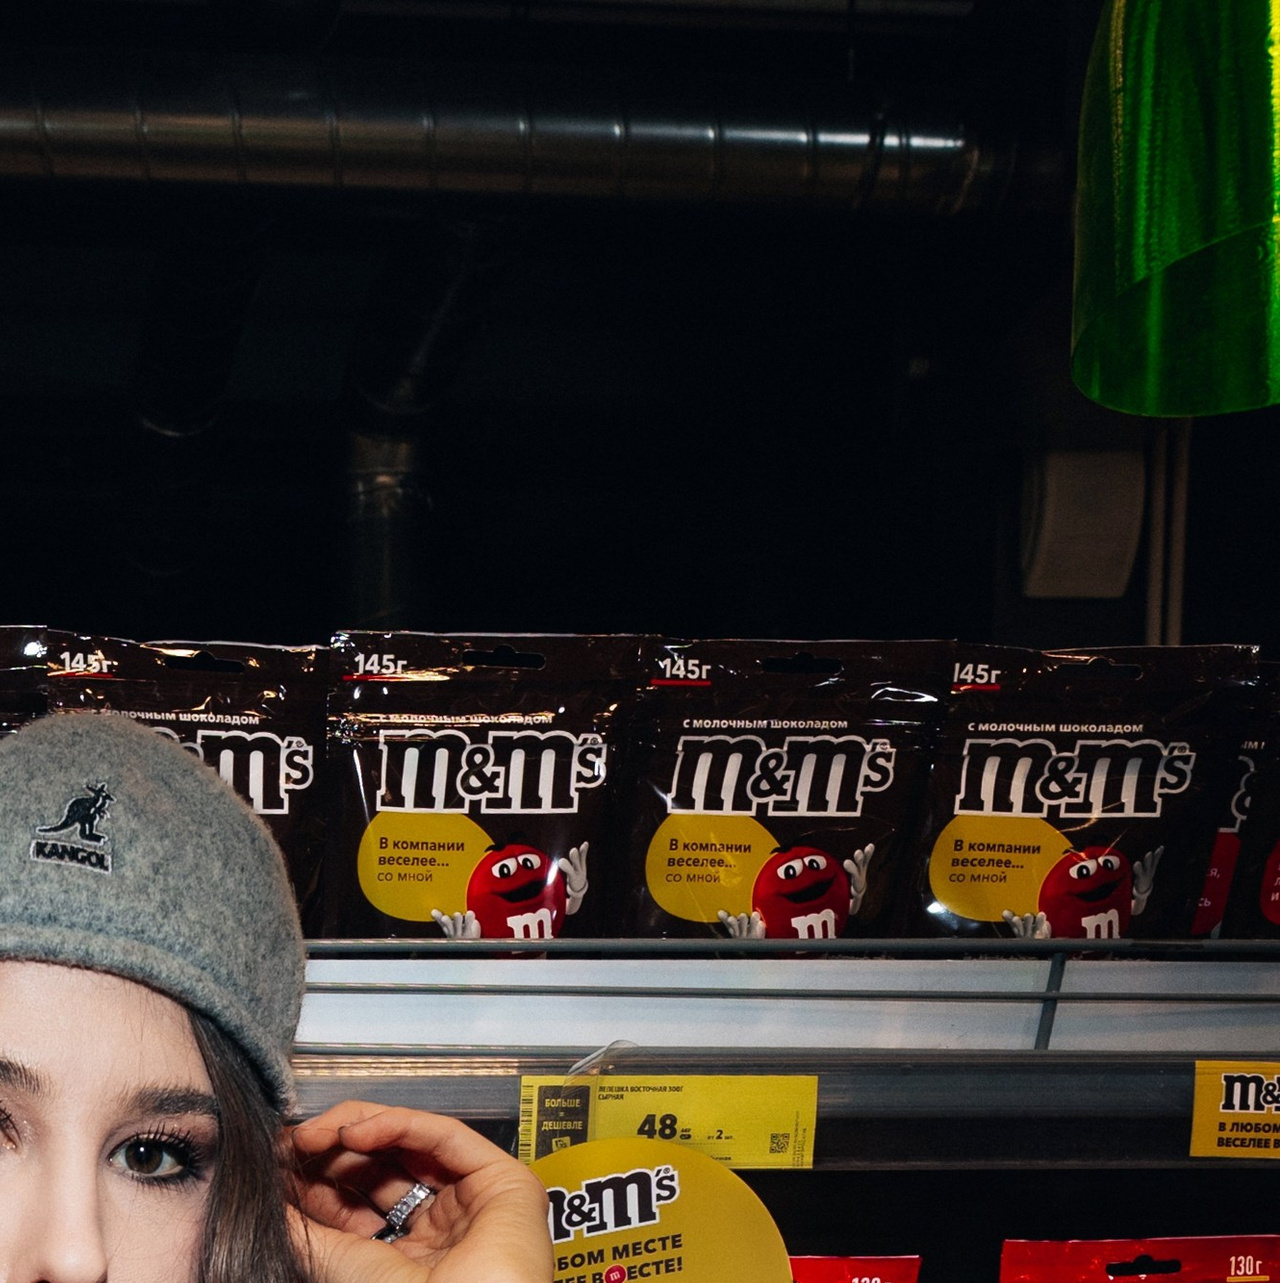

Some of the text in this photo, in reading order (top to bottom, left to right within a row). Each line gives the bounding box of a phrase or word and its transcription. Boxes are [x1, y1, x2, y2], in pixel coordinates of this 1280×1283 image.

[60, 651, 114, 673] 145г
[355, 653, 407, 674] 145г
[662, 658, 711, 679] 145г
[953, 662, 1001, 684] 145г
[179, 712, 260, 725] шоколадом
[693, 718, 848, 731] молочным шоколадом
[978, 722, 1144, 735] молочным шоколадом
[392, 839, 465, 852] компании
[682, 841, 751, 853] компании
[968, 841, 1041, 854] компании
[33, 841, 111, 872] KANGOL
[378, 855, 450, 867] веселее...
[397, 869, 433, 882] мной
[970, 870, 1007, 883] мной
[545, 1097, 581, 1108] БОЛЬШЕ
[541, 1120, 583, 1131] ДЕШЕВЛЕ
[637, 1113, 678, 1140] 48
[715, 1129, 723, 1140] 2
[1217, 1136, 1271, 1149] ВЕСЕЛЕЕ
[611, 1234, 683, 1261] МЕСТЕ
